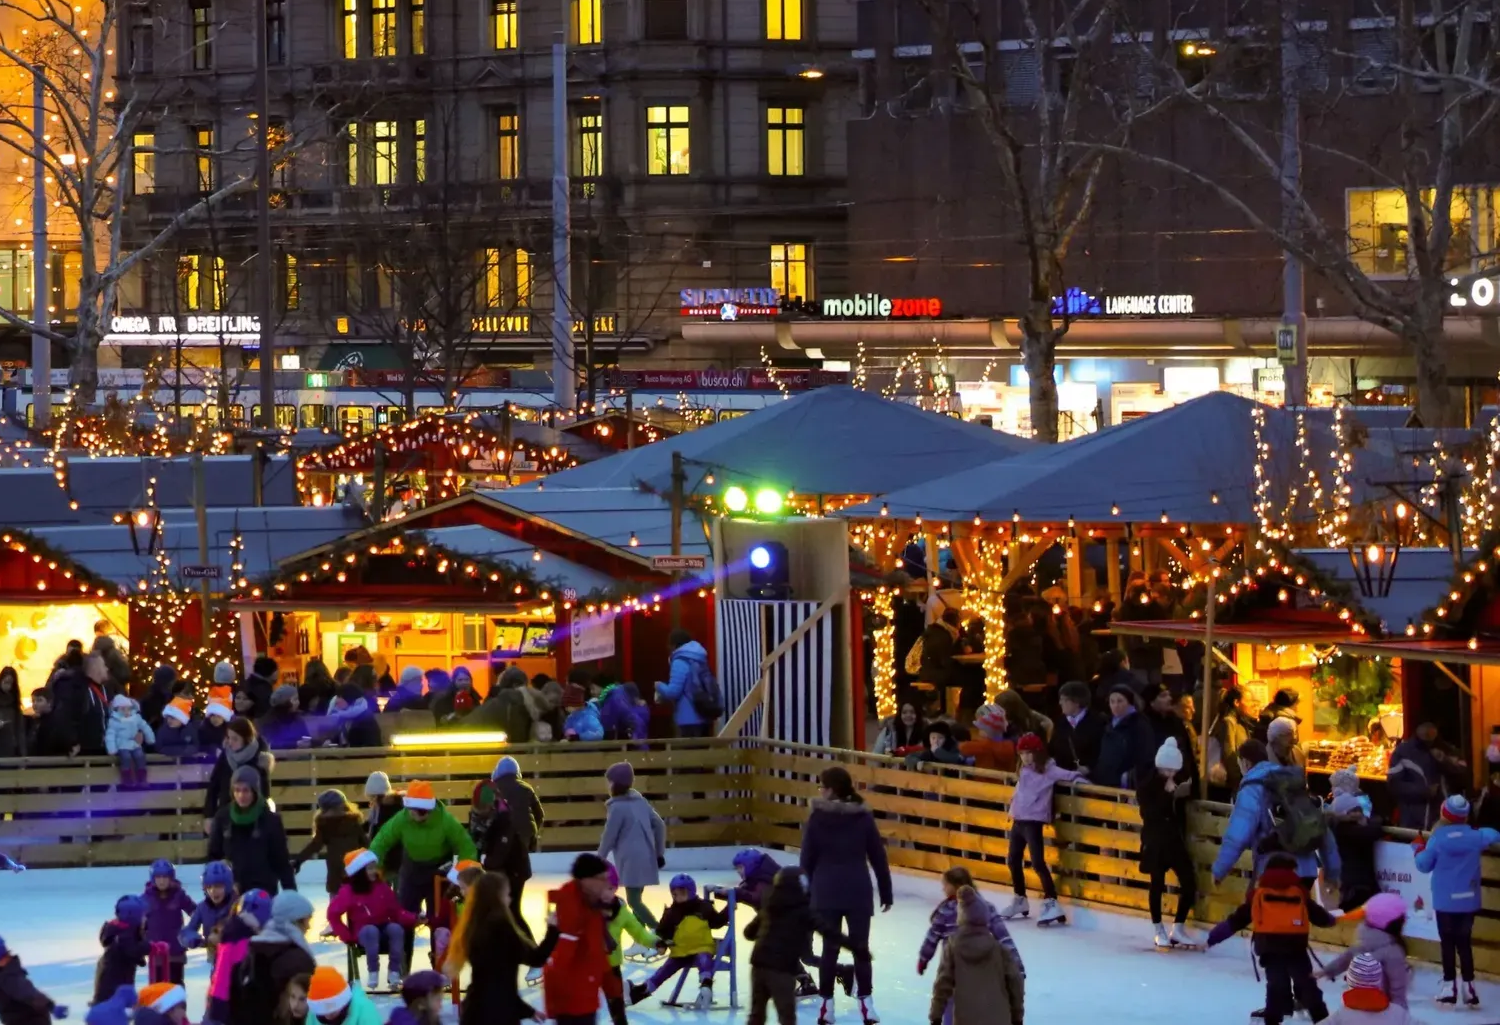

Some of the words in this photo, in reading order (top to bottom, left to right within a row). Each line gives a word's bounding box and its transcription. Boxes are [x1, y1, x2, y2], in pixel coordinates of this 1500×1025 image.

[823, 293, 941, 316] mobilezone
[1106, 295, 1156, 314] LANGUAGE
[1158, 294, 1193, 314] CENTER
[111, 316, 150, 332] OMEGA
[187, 316, 261, 332] BREITLING
[471, 316, 529, 332] BELLEVUE
[683, 375, 692, 383] AG
[701, 374, 743, 387] busco.ch
[793, 375, 802, 383] AG
[564, 588, 576, 600] 99
